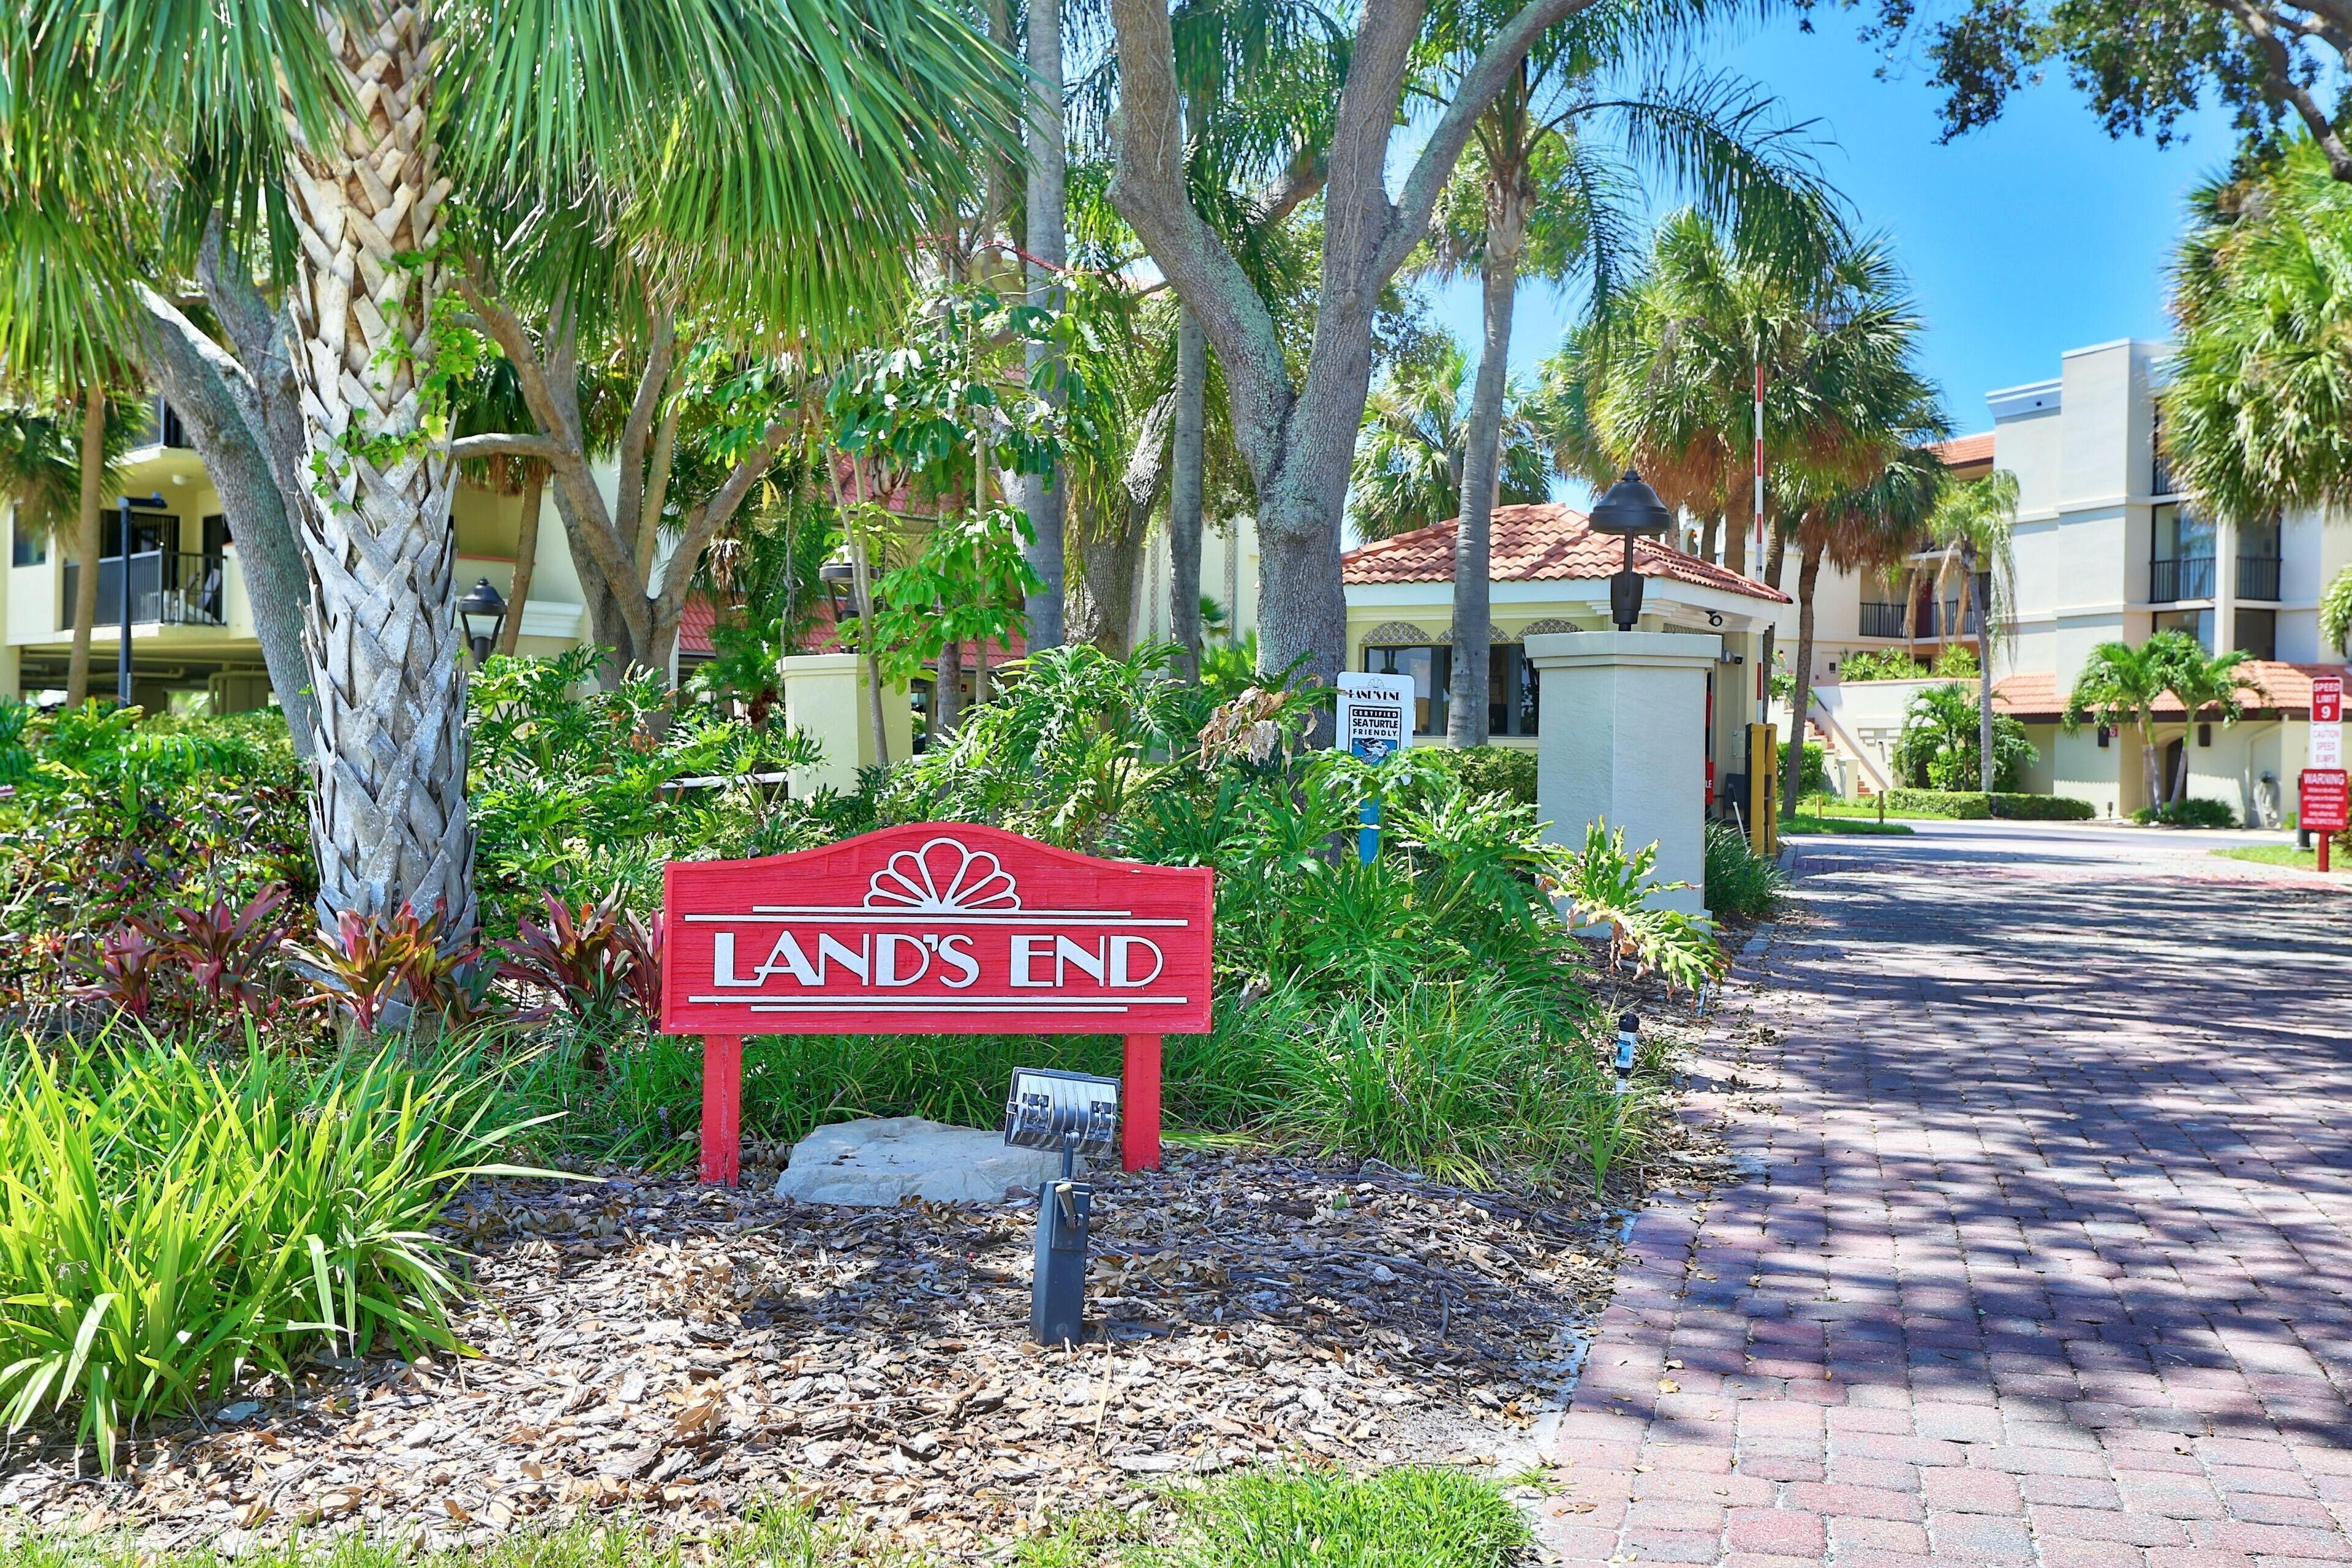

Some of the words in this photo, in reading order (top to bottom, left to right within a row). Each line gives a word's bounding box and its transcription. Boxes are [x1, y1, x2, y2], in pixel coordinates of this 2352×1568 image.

[2313, 682, 2339, 692] SPEED
[1384, 691, 1402, 701] END
[2316, 694, 2337, 704] LIMIT
[2321, 705, 2331, 719] 9
[1352, 718, 1369, 727] SEA
[1369, 719, 1398, 729] TURTLE
[2303, 773, 2345, 786] WARNING
[714, 930, 980, 989] LAND'S
[1010, 935, 1164, 988] END
